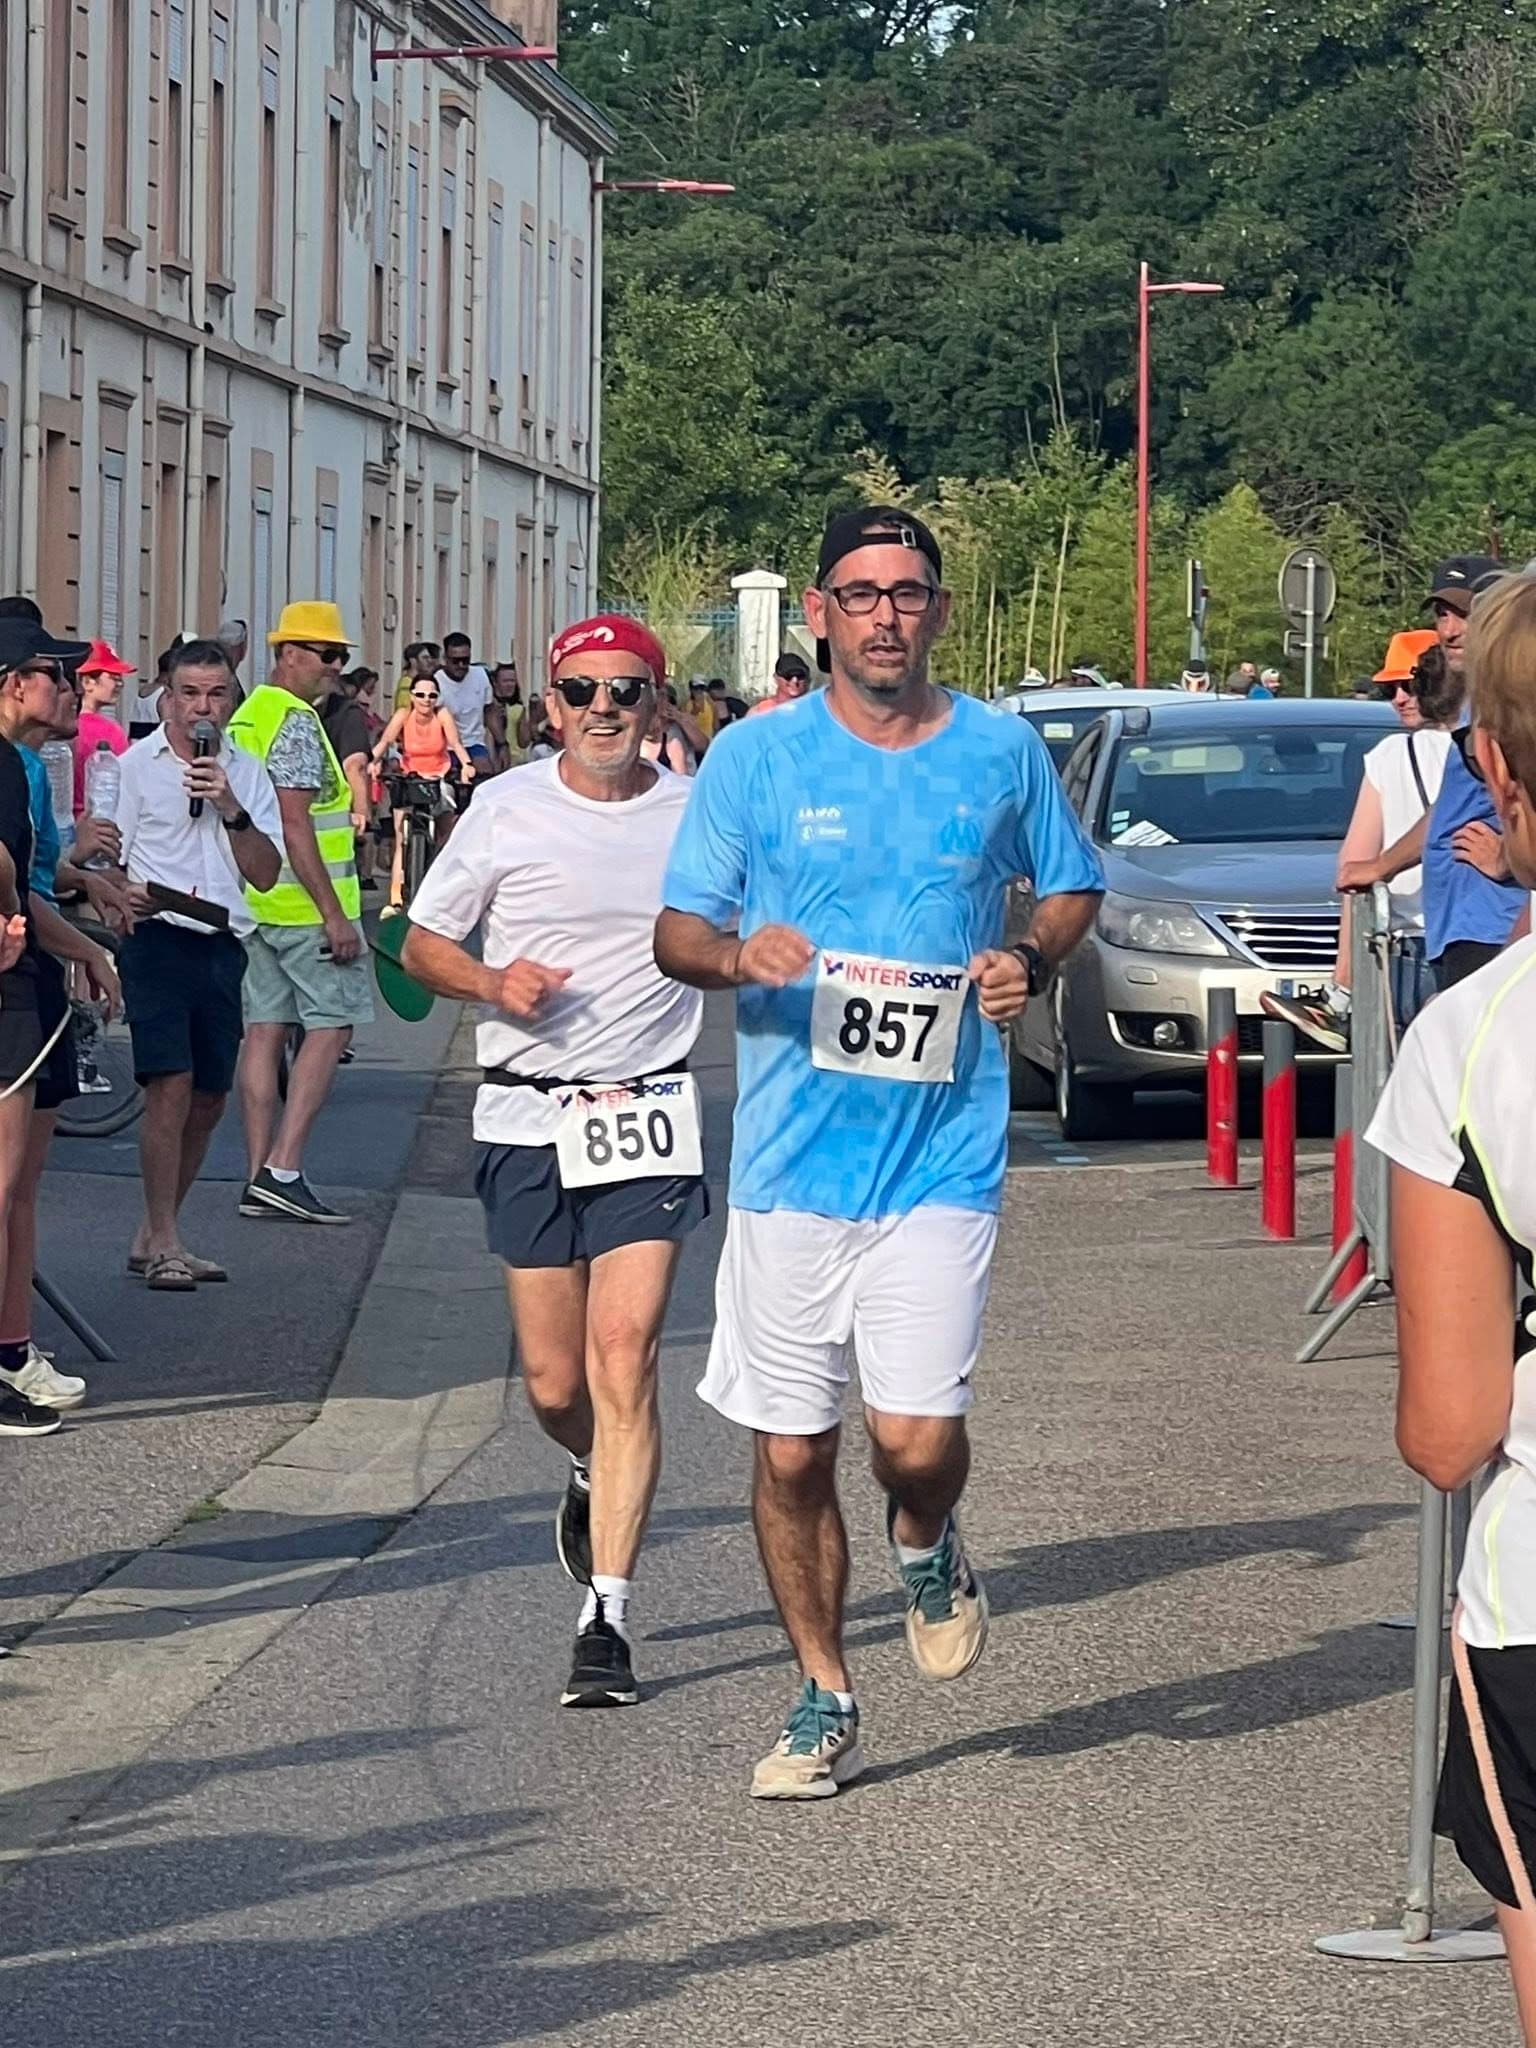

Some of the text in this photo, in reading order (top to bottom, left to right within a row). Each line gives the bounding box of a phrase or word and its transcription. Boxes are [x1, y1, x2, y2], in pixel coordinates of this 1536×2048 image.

[845, 961, 964, 991] INTERSPORT
[838, 997, 940, 1063] 857
[583, 1108, 674, 1167] 850
